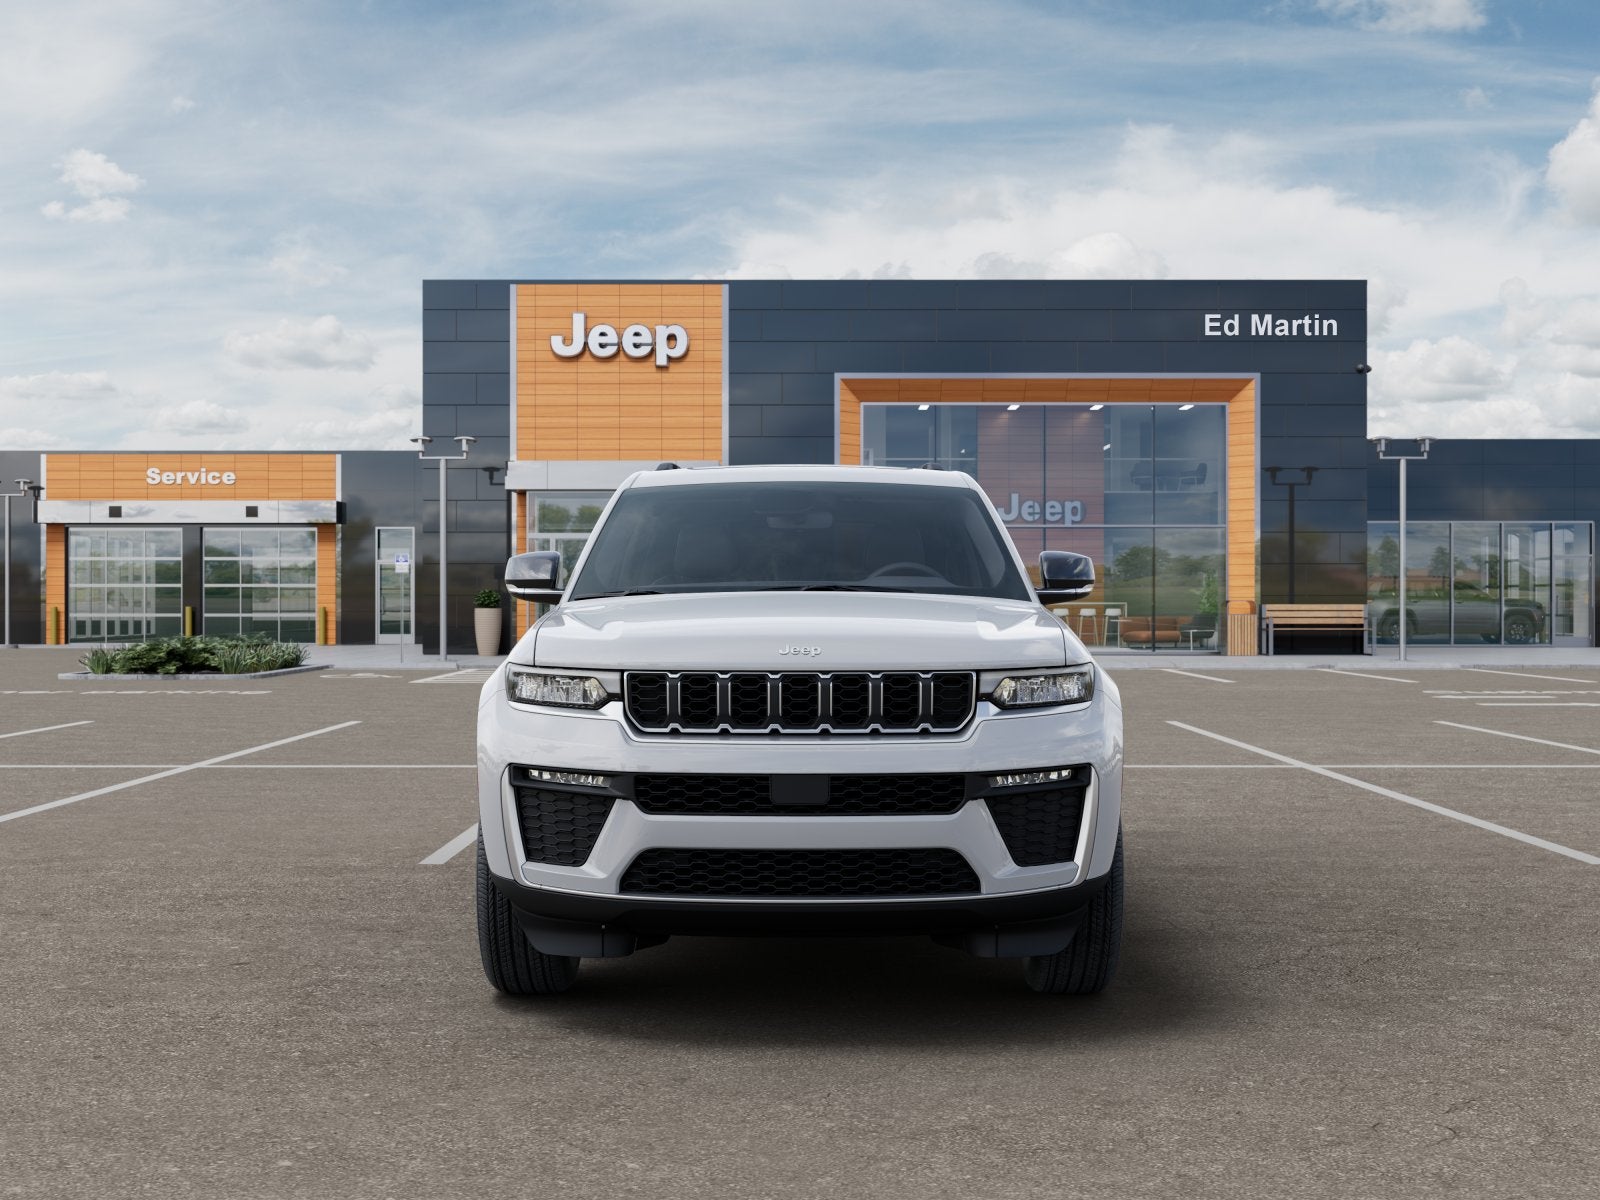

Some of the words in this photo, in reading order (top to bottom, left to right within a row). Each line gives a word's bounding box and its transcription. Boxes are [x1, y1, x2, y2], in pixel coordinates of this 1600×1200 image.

[1204, 313, 1239, 336] Ed
[1250, 313, 1338, 336] Martin
[550, 311, 689, 368] Jeep
[146, 467, 236, 485] Service
[997, 493, 1085, 526] Jeep
[778, 642, 822, 657] Jeep
